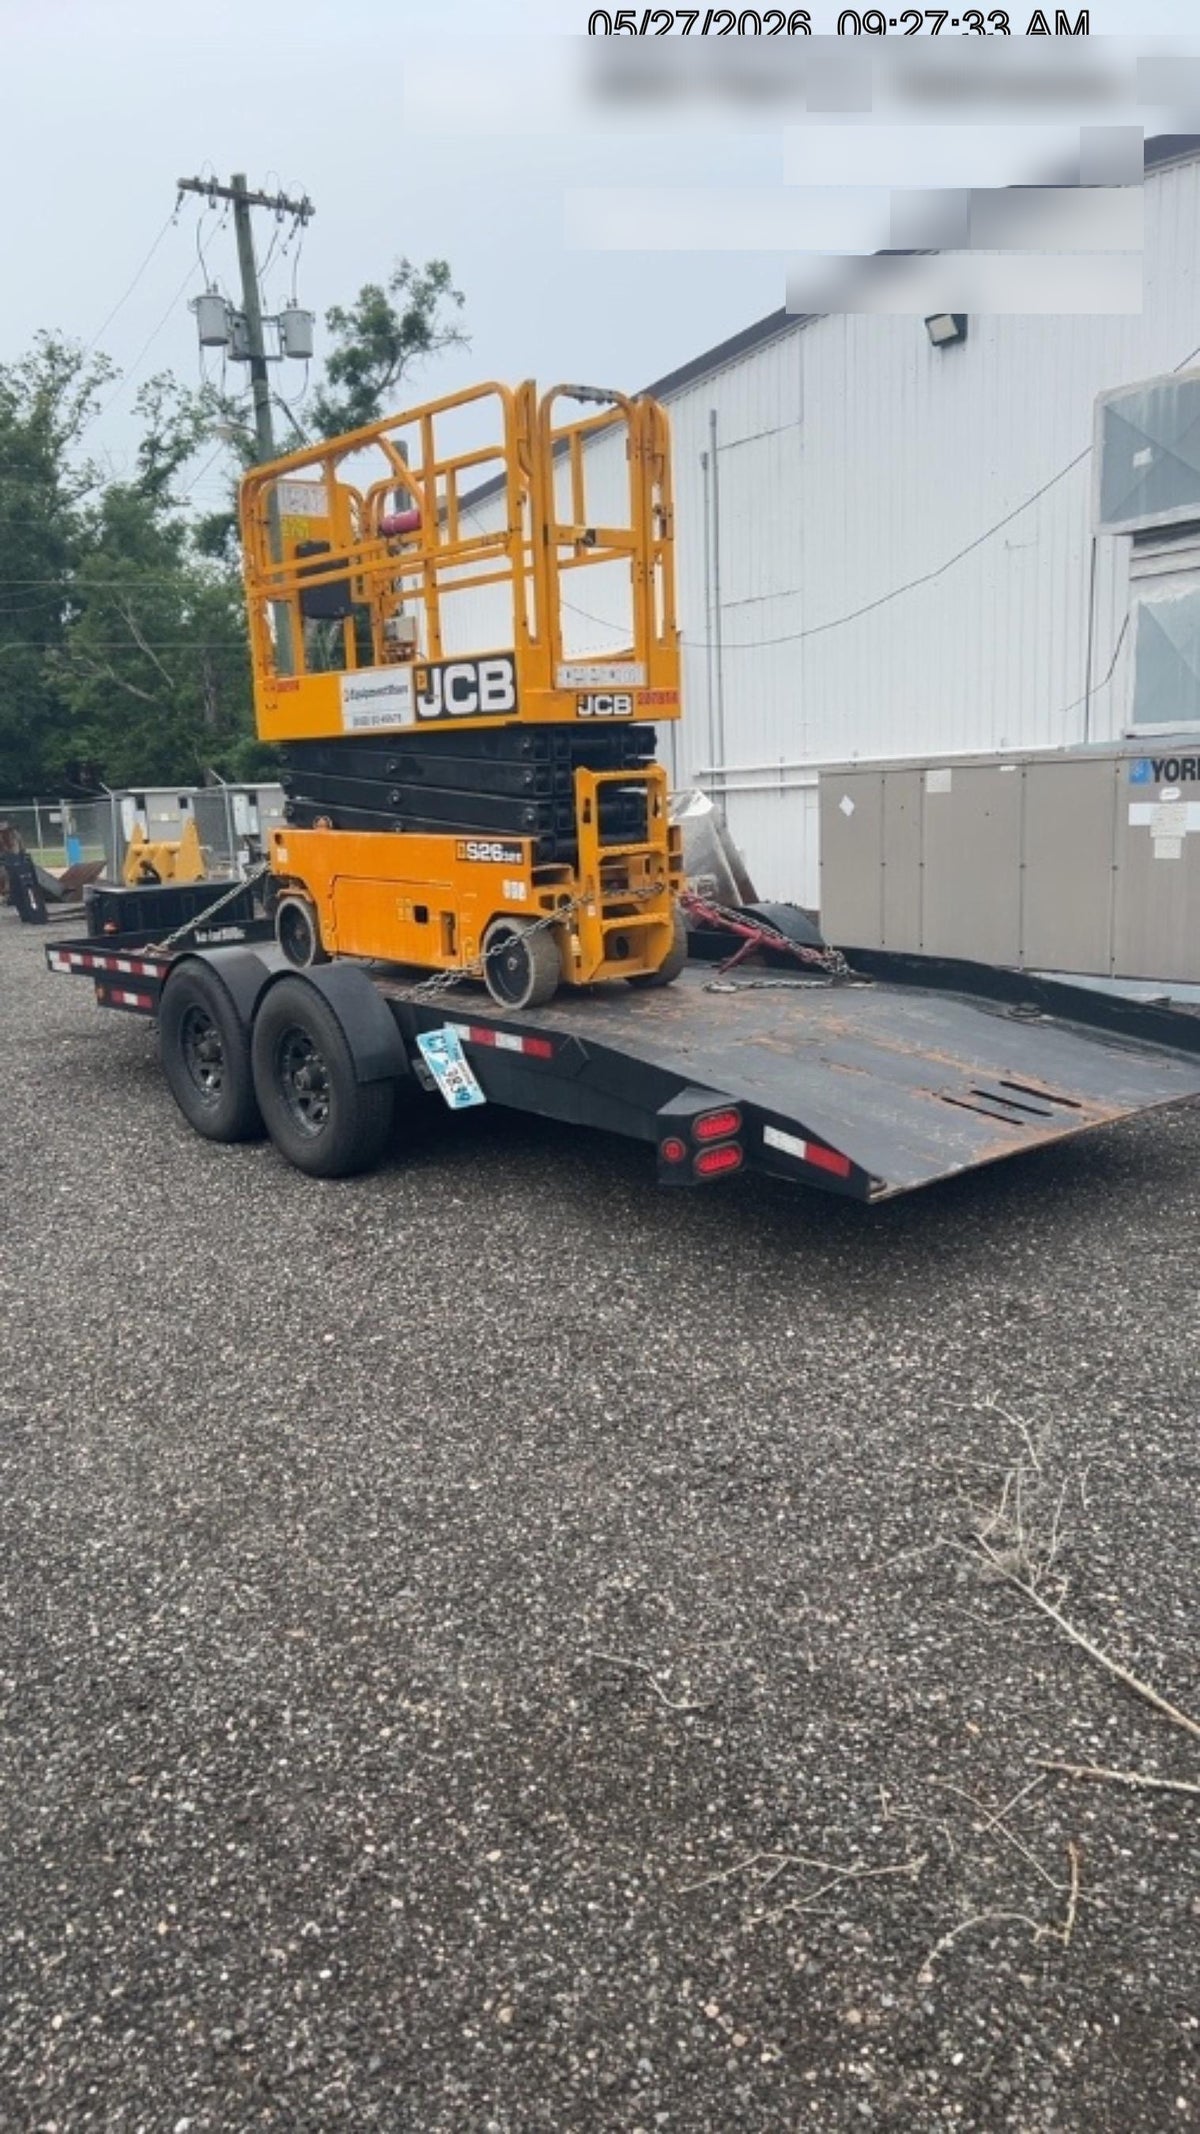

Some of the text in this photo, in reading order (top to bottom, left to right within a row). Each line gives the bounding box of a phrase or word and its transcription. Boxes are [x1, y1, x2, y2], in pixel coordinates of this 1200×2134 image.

[417, 658, 516, 718] JCB
[577, 694, 634, 716] JCB
[1151, 757, 1200, 783] YOR
